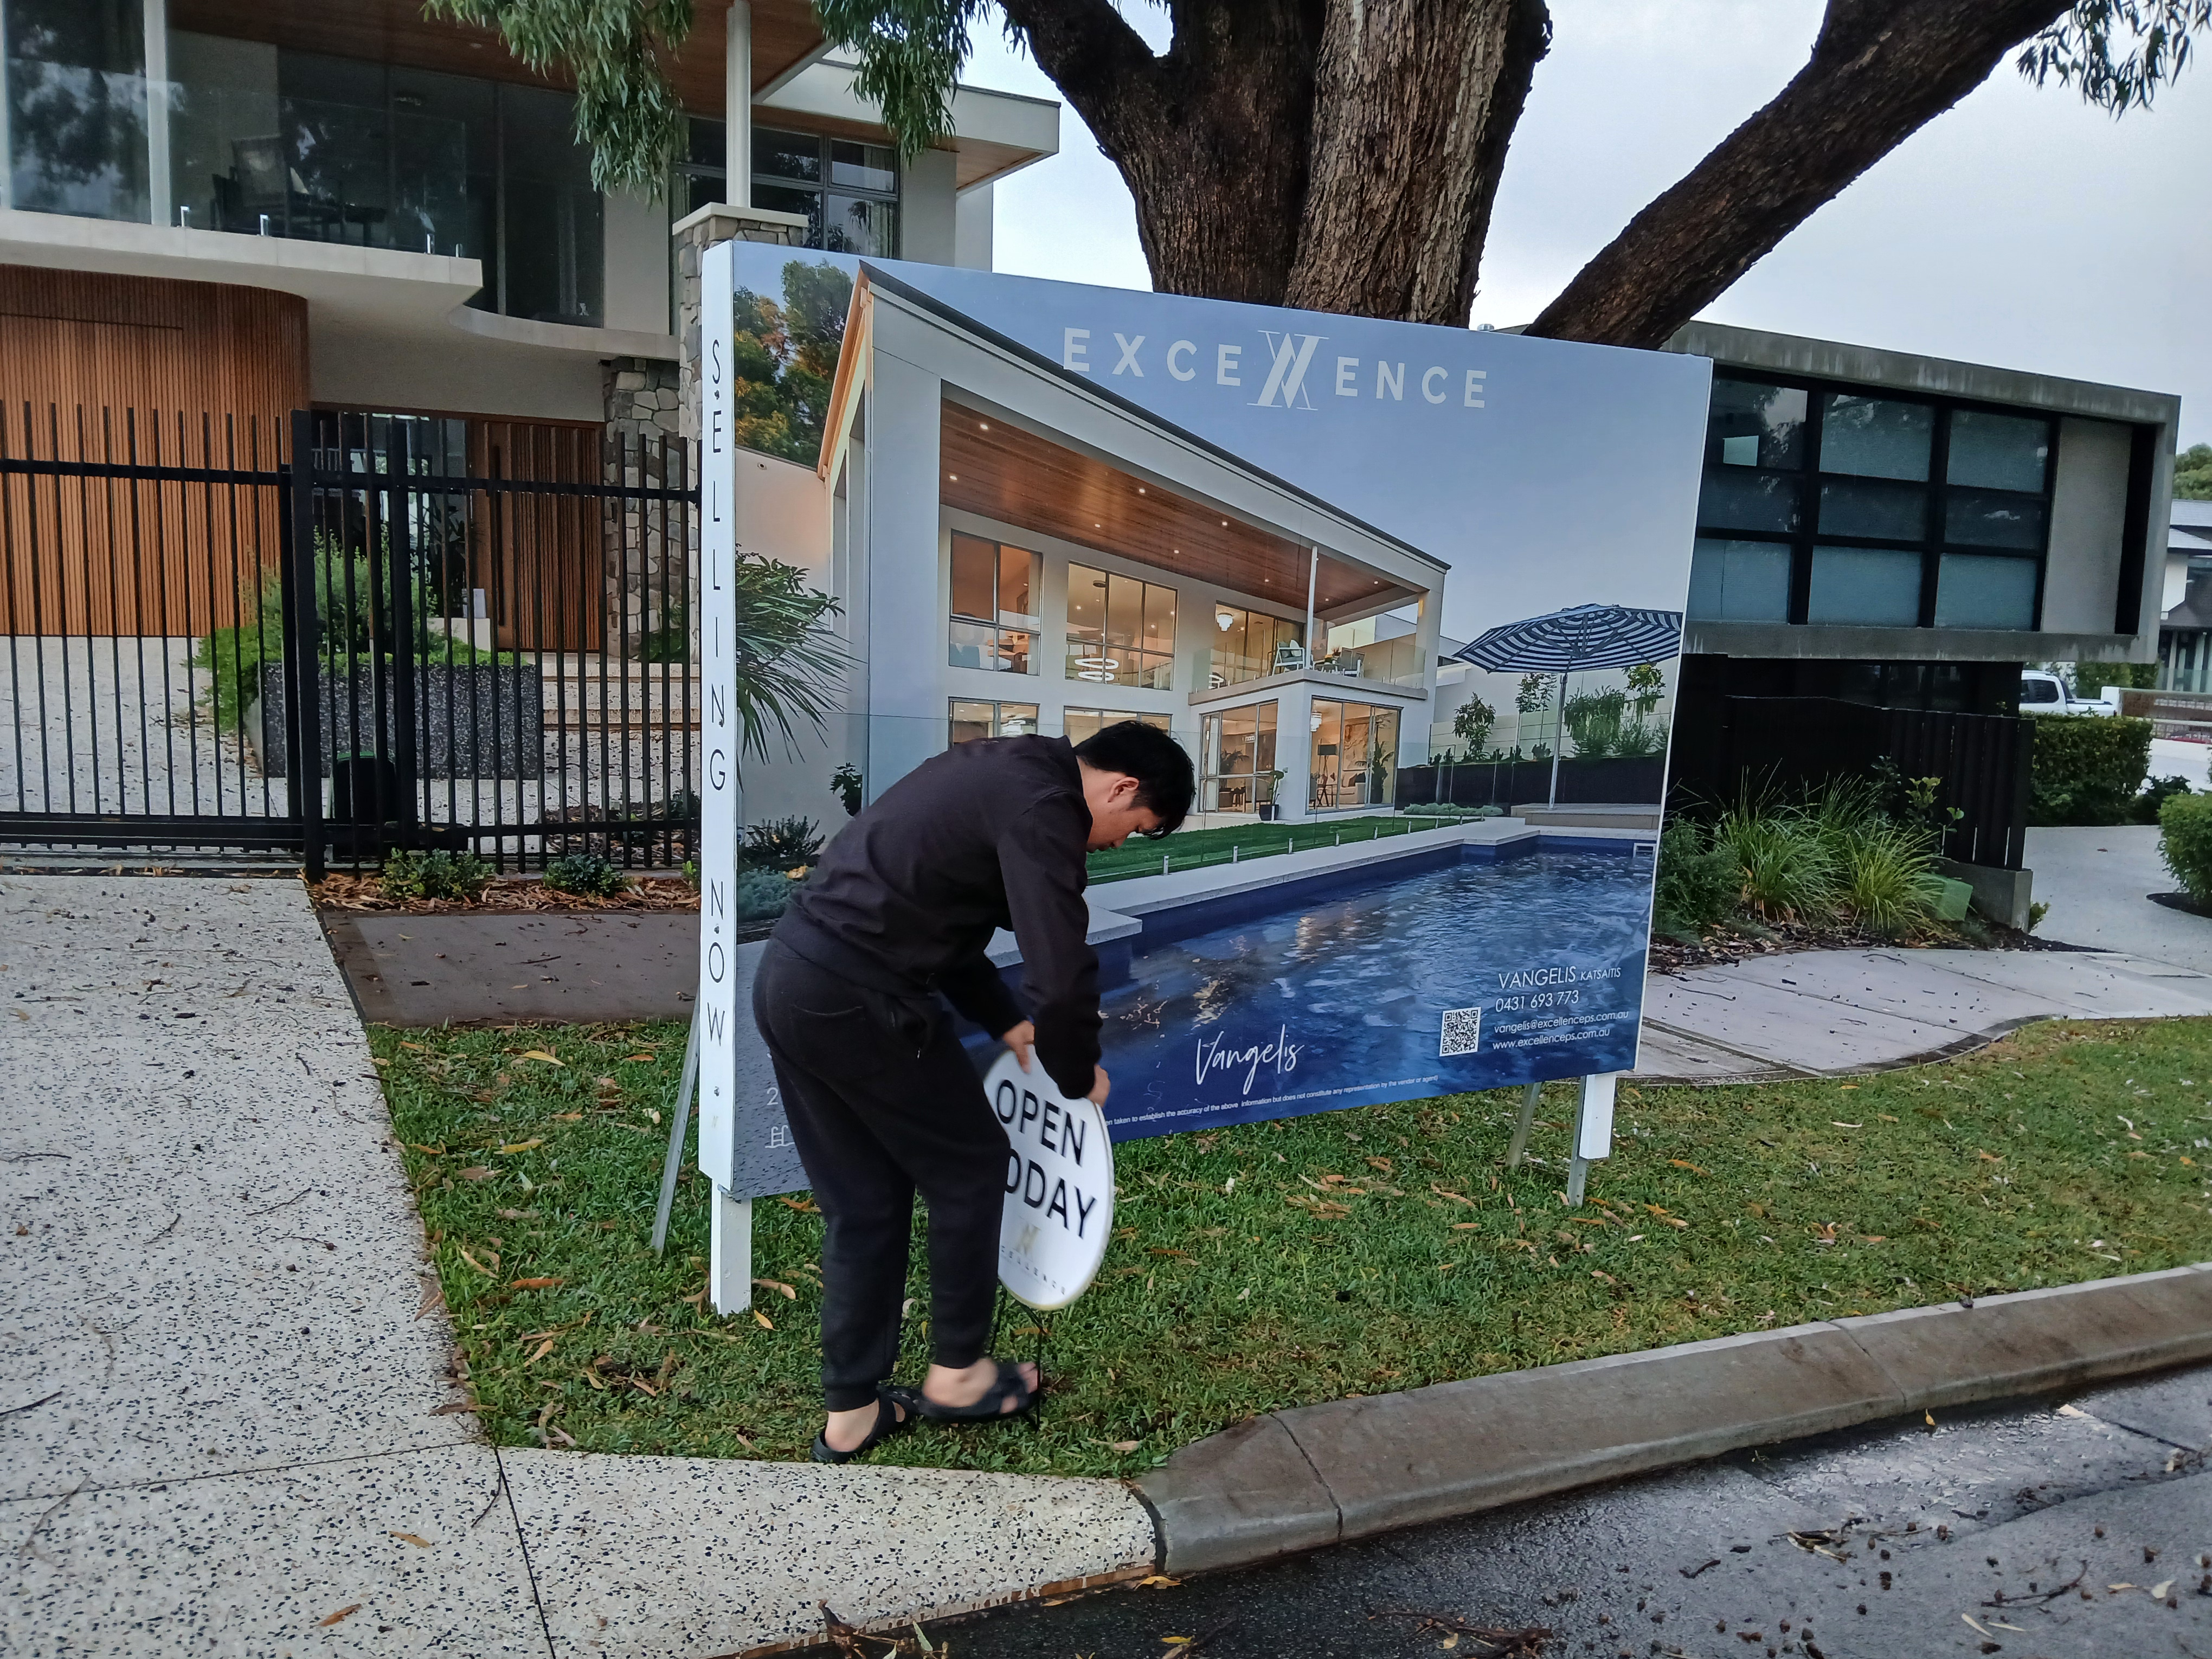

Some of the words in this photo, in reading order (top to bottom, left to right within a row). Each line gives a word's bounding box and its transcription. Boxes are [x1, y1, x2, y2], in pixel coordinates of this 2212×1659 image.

[709, 339, 726, 790] SELLING
[707, 878, 725, 1047] NOW
[1498, 966, 1576, 989] VANGELIS
[1580, 967, 1621, 981] KATSAITIS
[1495, 996, 1525, 1012] 0431
[1531, 993, 1553, 1008] 693
[1557, 990, 1579, 1006] 773
[1493, 1029, 1610, 1050] www.excellenceps.com.au
[1494, 1011, 1629, 1034] vangelis@excellenceps.com.au
[1195, 1024, 1304, 1095] Vangelis
[767, 1087, 779, 1105] 2
[1139, 1112, 1165, 1121] establish
[1177, 1108, 1203, 1116] accuracy
[1241, 1098, 1271, 1107] information
[1306, 1089, 1332, 1098] constitute
[1343, 1083, 1380, 1093] representation
[996, 1079, 1086, 1168] OPEN
[1005, 1148, 1097, 1240] ODAY
